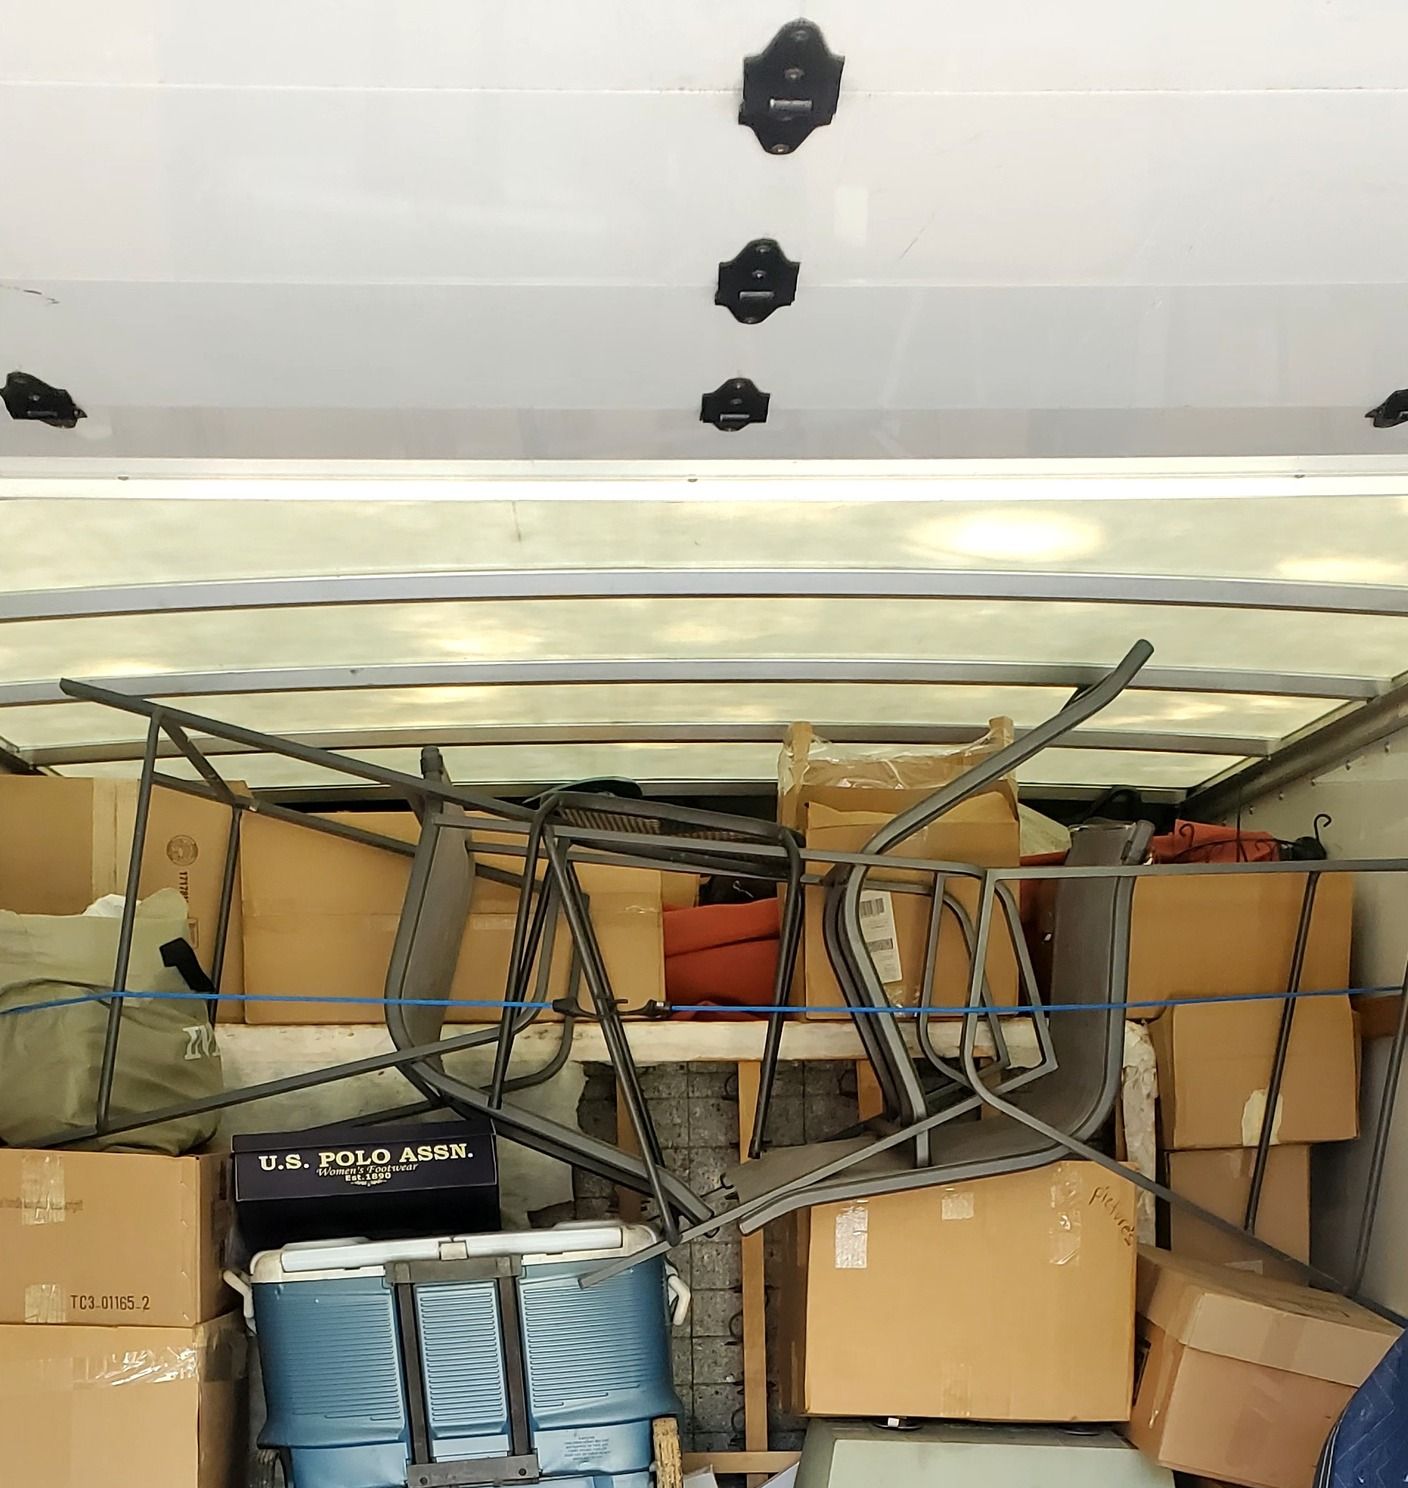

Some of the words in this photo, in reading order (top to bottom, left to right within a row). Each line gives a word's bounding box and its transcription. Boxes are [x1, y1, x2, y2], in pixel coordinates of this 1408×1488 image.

[258, 1154, 310, 1171] U.S.
[318, 1148, 392, 1168] POLO
[399, 1143, 474, 1163] ASSN.
[316, 1165, 365, 1178] Women's
[366, 1163, 419, 1174] Footwear
